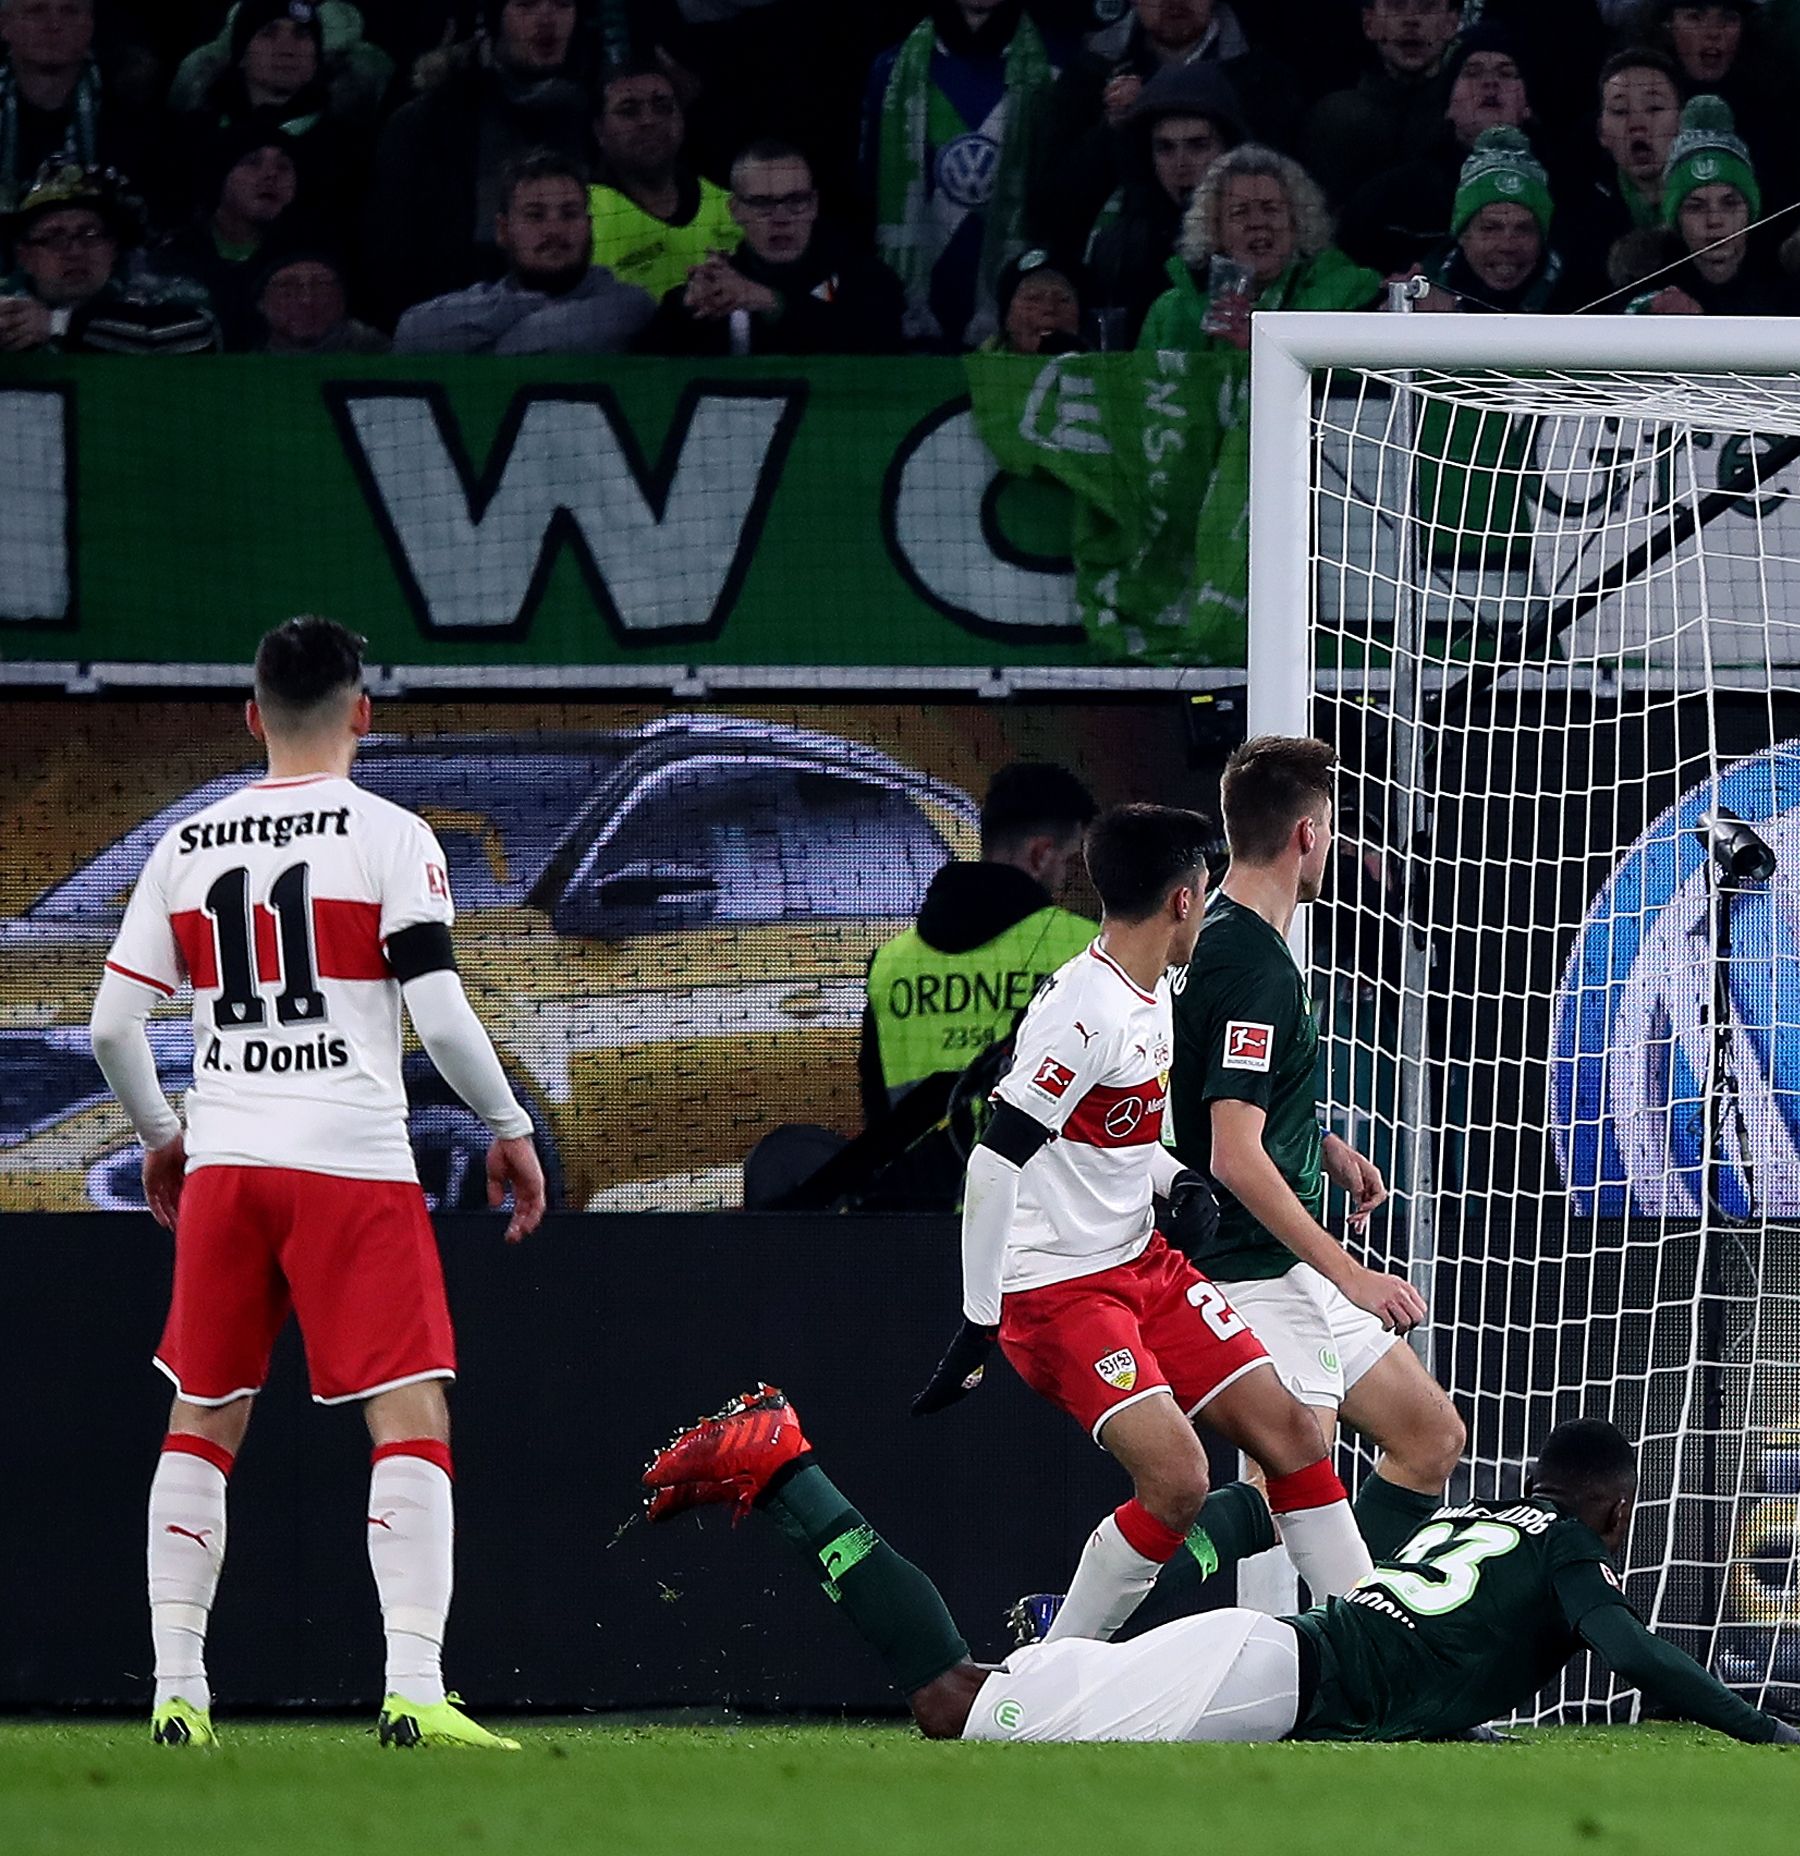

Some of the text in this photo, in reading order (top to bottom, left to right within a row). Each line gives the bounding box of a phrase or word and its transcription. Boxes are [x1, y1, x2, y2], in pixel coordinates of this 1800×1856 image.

[180, 807, 350, 854] Stuttgart
[205, 861, 328, 1030] 11
[202, 1034, 349, 1073] A. Donis
[1186, 1281, 1258, 1341] 2
